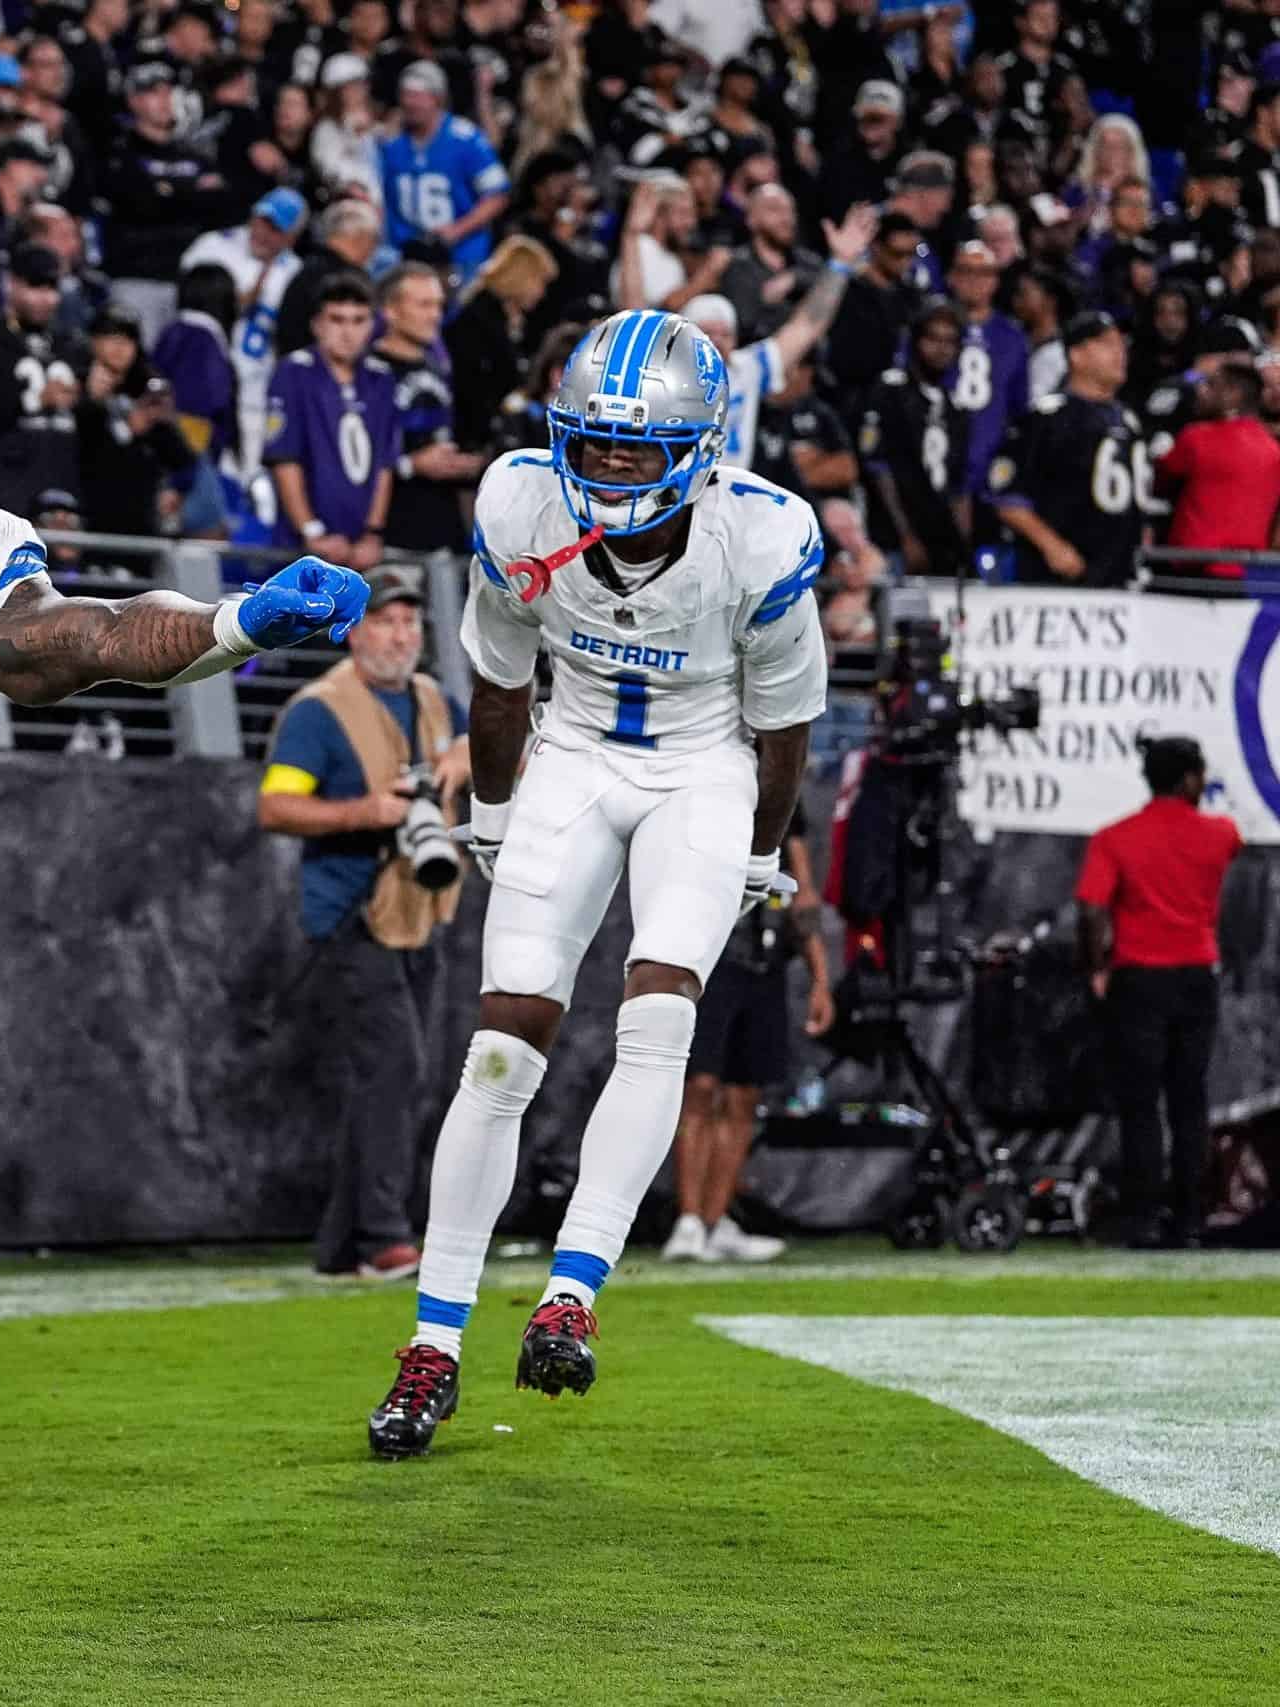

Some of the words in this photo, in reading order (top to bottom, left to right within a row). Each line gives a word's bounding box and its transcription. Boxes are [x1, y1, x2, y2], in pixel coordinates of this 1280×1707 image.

[398, 172, 454, 231] 16
[957, 346, 991, 411] 8
[338, 411, 372, 485] 0
[570, 630, 689, 672] DETROIT
[601, 670, 658, 751] 1
[960, 665, 1218, 706] OUCHDOWN
[984, 771, 1061, 812] PAD
